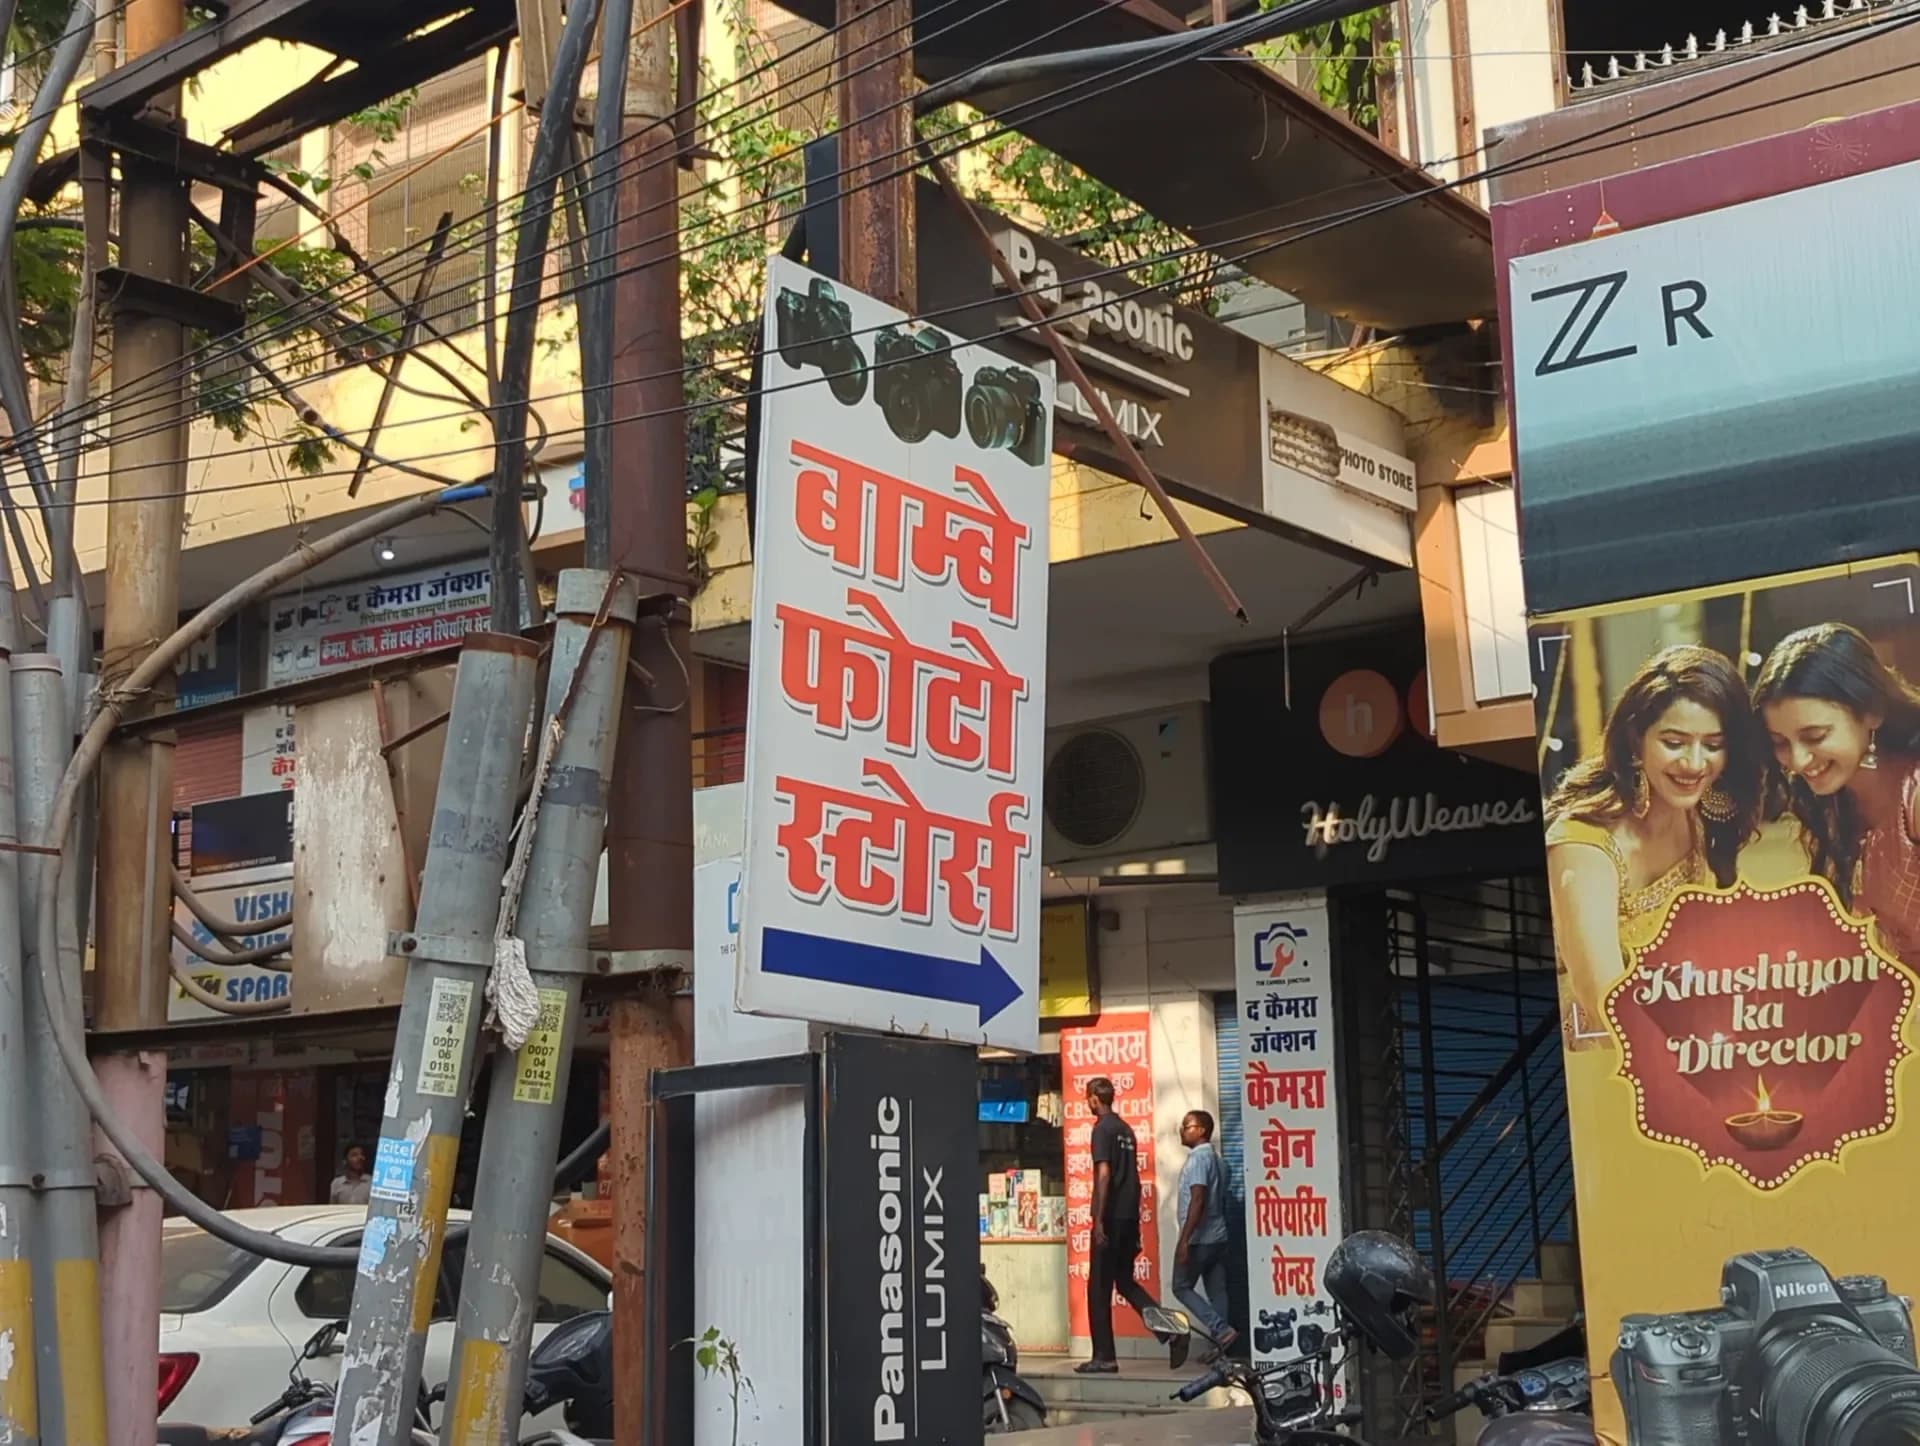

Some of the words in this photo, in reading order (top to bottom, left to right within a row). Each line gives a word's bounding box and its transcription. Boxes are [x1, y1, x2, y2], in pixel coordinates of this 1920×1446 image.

[993, 229, 1194, 362] Paasonic
[1660, 279, 1714, 346] R
[1378, 463, 1414, 492] STORE
[789, 438, 1031, 624] बाम्बे
[346, 594, 360, 613] द
[365, 584, 423, 610] कैमरा
[775, 587, 1026, 776] फोटो
[775, 757, 1029, 936] स्टोर्स
[234, 891, 294, 922] VISH
[226, 974, 294, 1003] SPAR
[1633, 950, 1880, 1006] Khushiyon
[1246, 1000, 1261, 1021] द
[1264, 992, 1319, 1020] कैमरा
[1732, 994, 1784, 1032] ka
[527, 1044, 554, 1056] 0007
[1249, 1025, 1317, 1054] जंक्शन
[1666, 1031, 1863, 1075] Director
[524, 1068, 551, 1081] 0142
[533, 1057, 546, 1068] 04
[1245, 1061, 1327, 1111] कैमरा
[1064, 1100, 1098, 1120] CBS
[870, 1096, 905, 1442] Panasonic
[921, 1166, 948, 1371] LUMIX
[1774, 1281, 1830, 1299] Nikon
